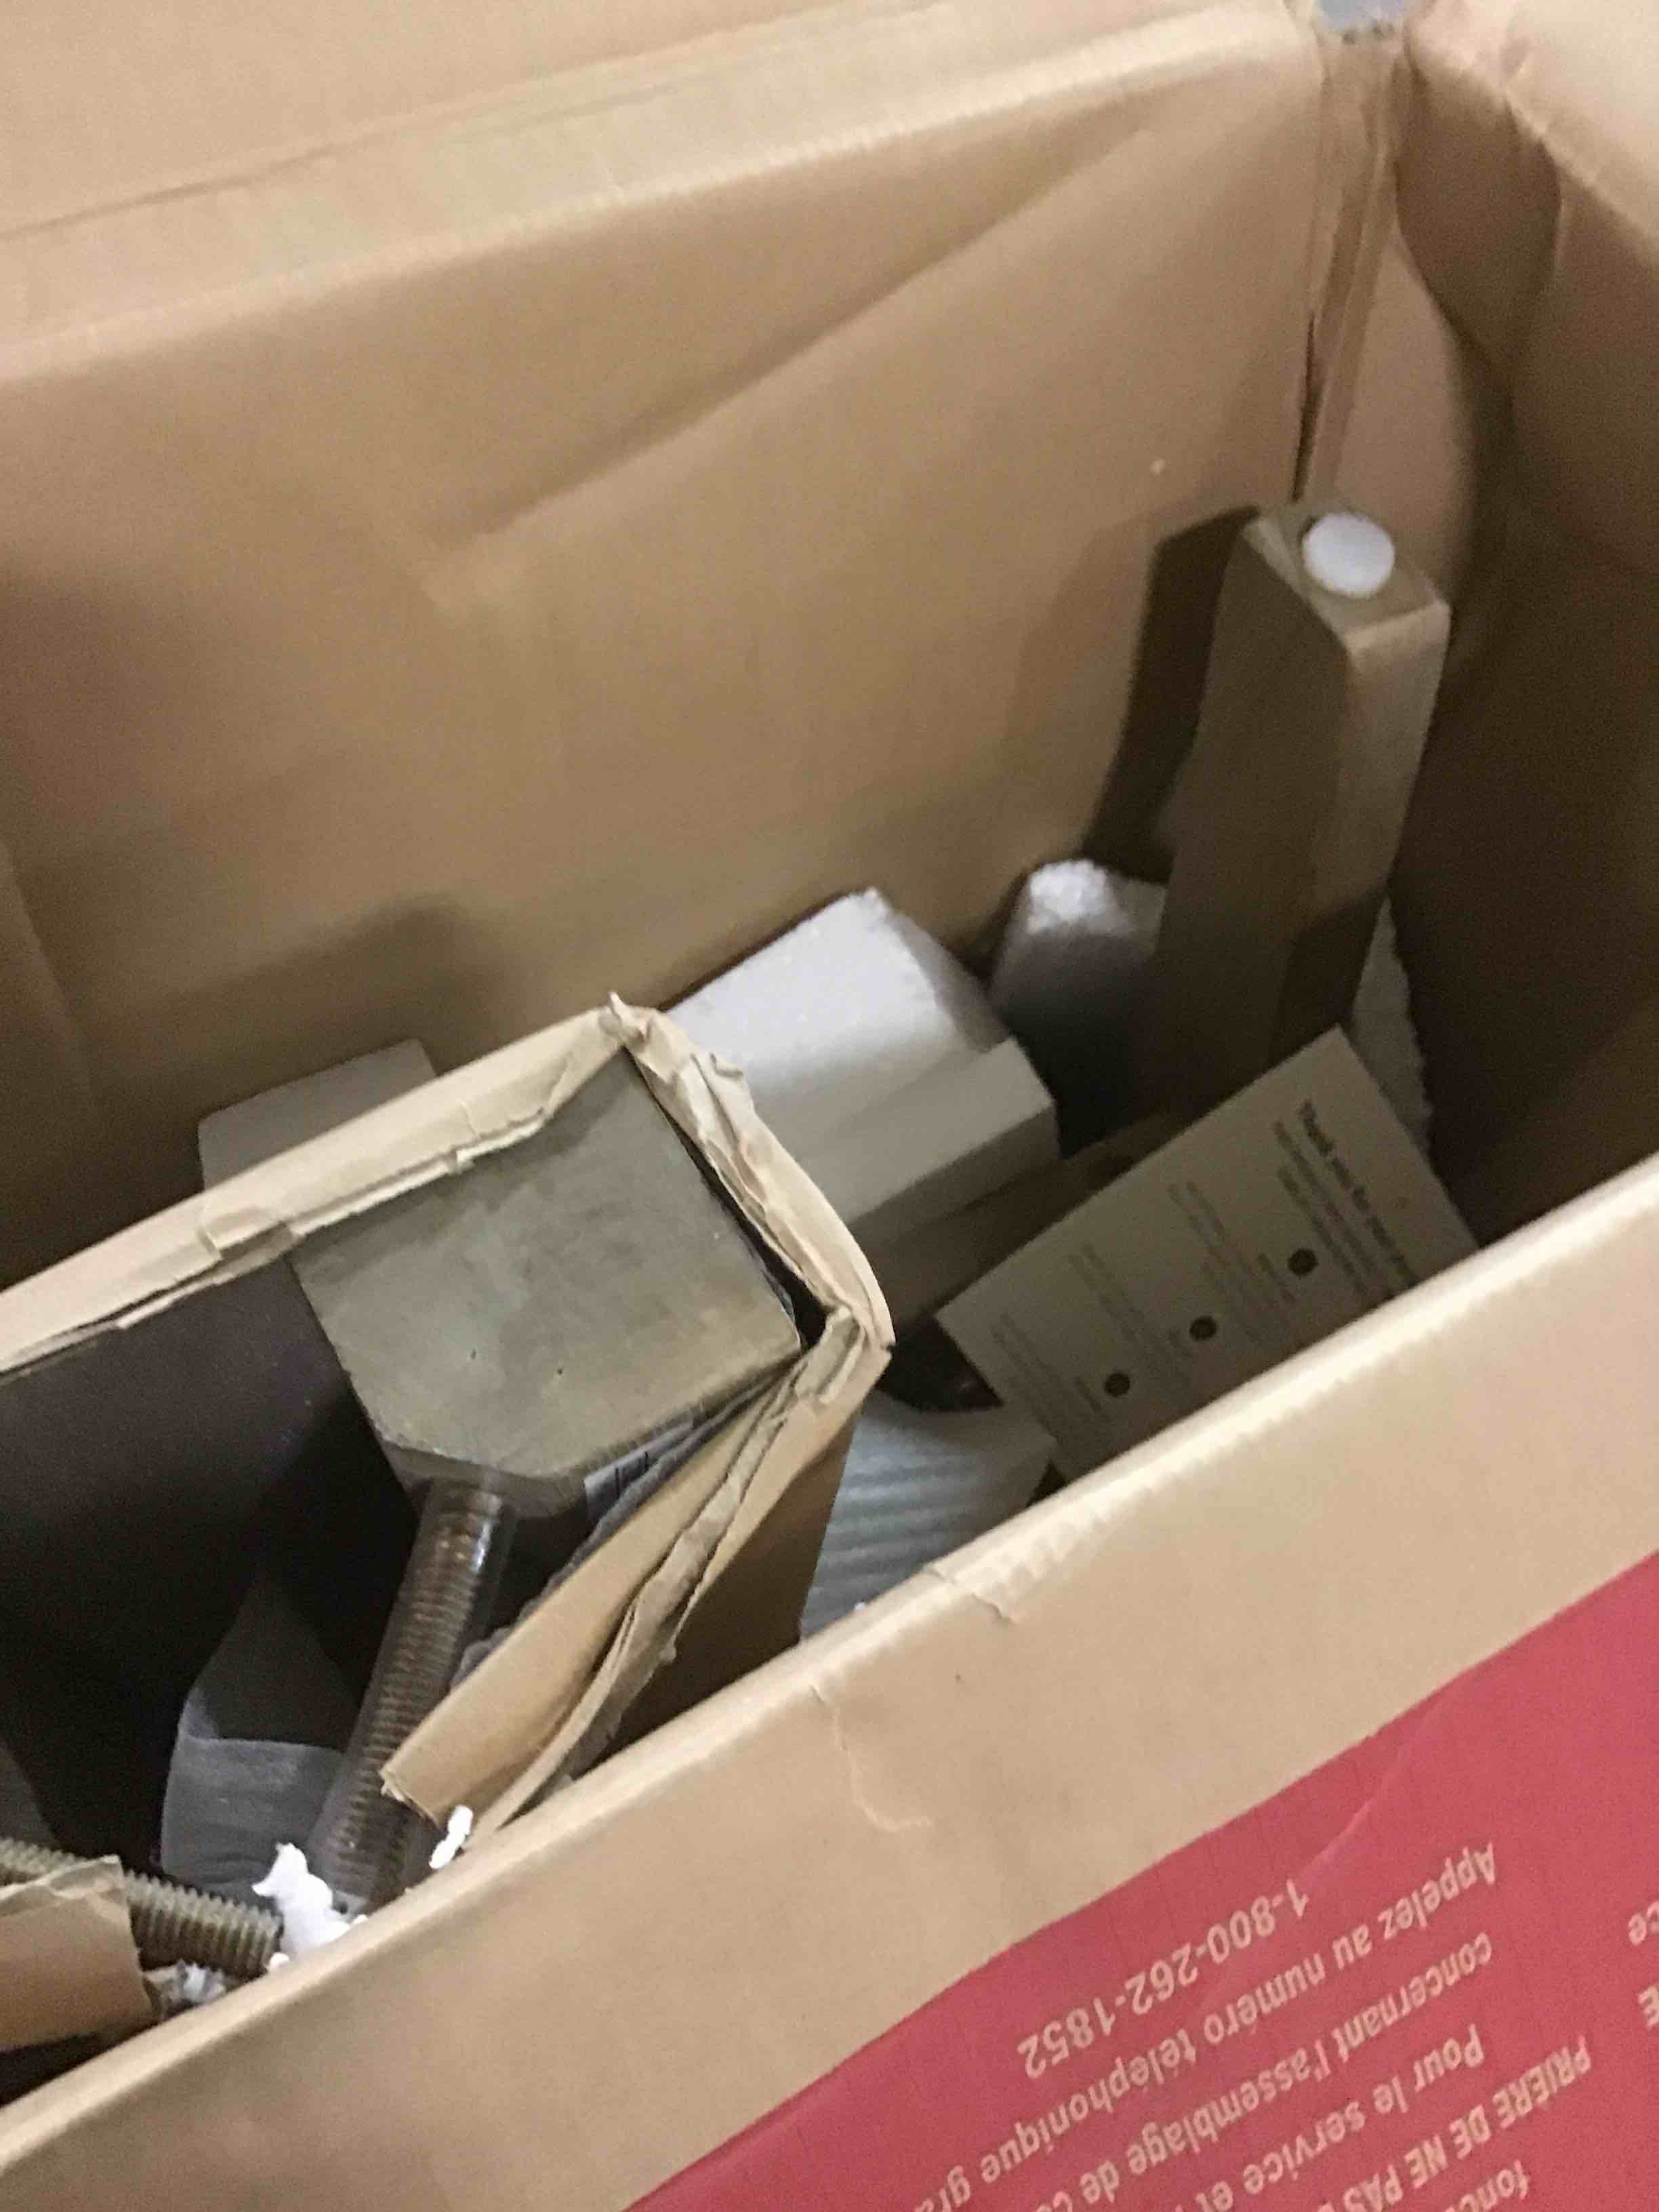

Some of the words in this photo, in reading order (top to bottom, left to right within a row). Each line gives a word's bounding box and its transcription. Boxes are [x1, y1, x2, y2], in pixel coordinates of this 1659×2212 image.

[1378, 1843, 1496, 1940] Appelez
[1017, 1879, 1309, 2079] 1-800-262-1852
[1332, 1923, 1372, 1971] au
[1203, 1952, 1326, 2045] numéro
[1332, 1932, 1492, 2064] concernant
[1414, 2024, 1484, 2093] Pour
[981, 2028, 1197, 2184] téléphonique
[1126, 2040, 1331, 2175] l'assemblage
[1372, 2076, 1409, 2113] le
[1242, 2102, 1366, 2194] service
[1404, 2134, 1448, 2189] NE
[1449, 2104, 1492, 2159] DE
[1080, 2160, 1120, 2203] de
[1344, 2164, 1404, 2212] PAS
[1442, 2160, 1526, 2212] fonc
